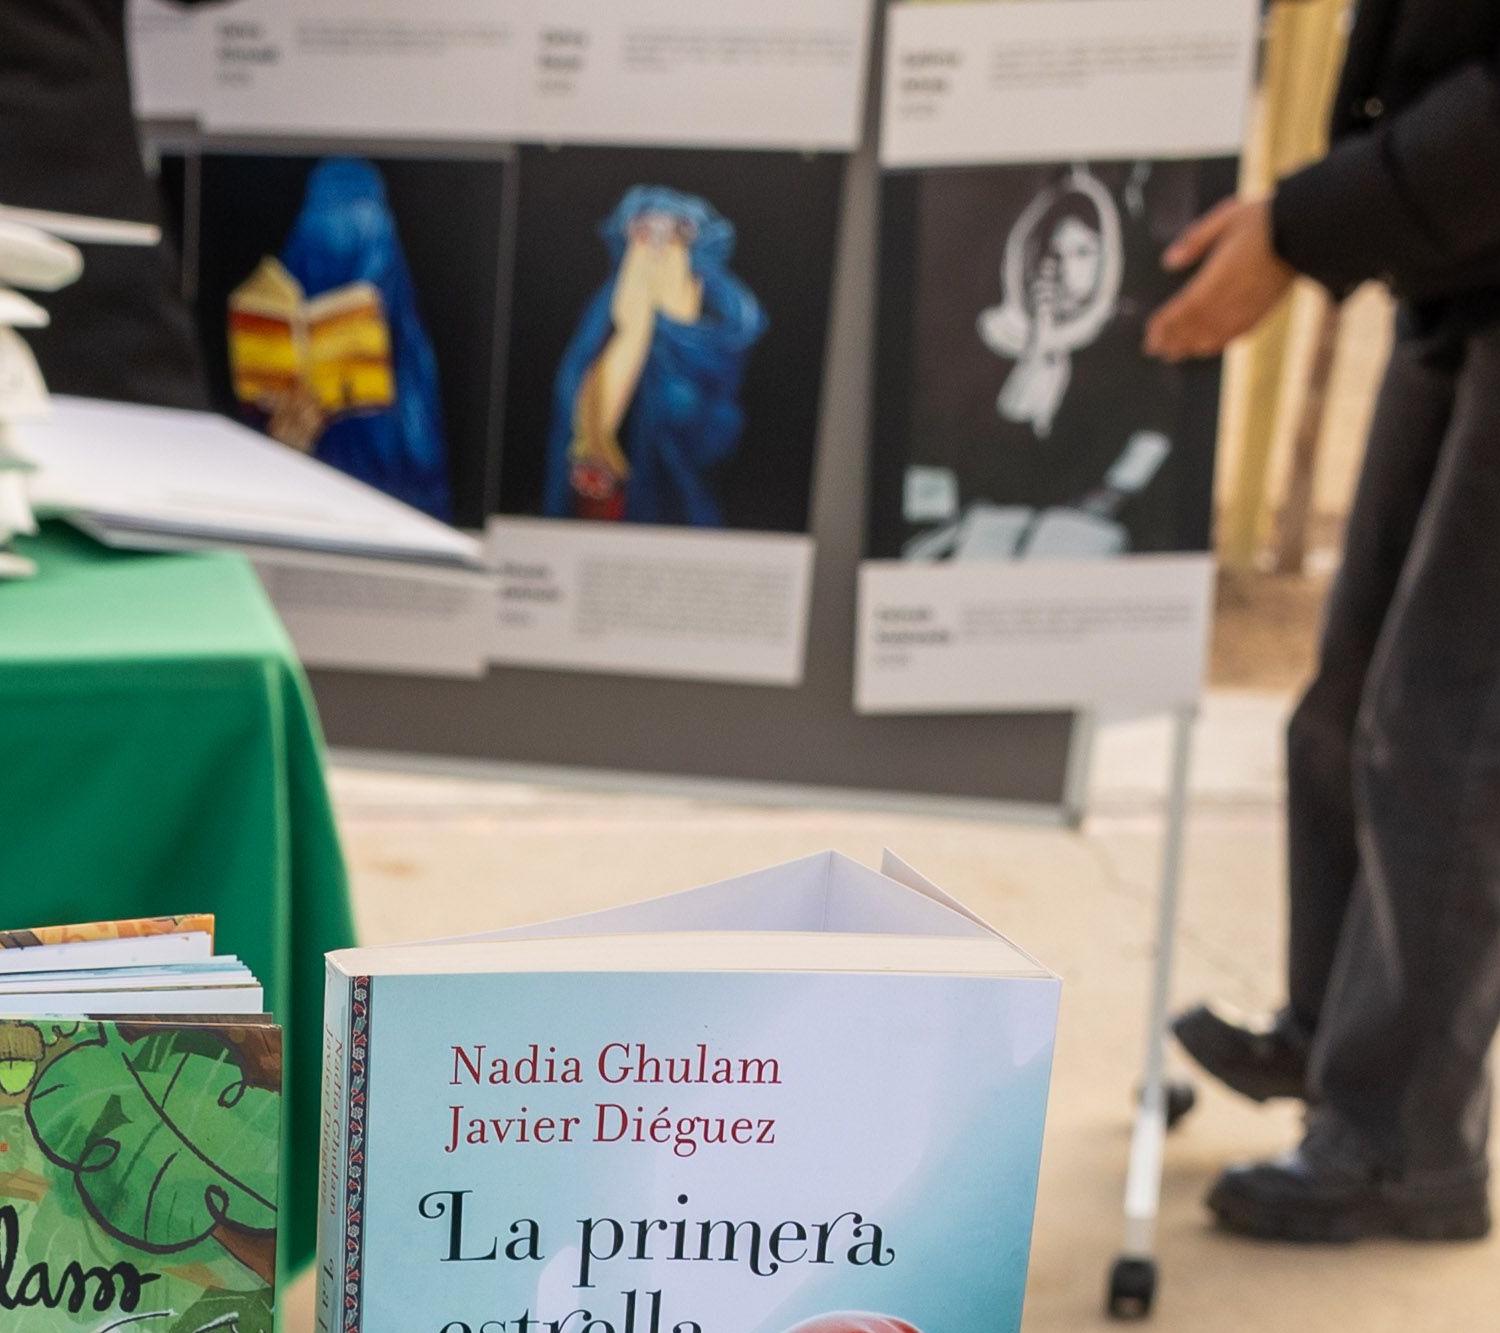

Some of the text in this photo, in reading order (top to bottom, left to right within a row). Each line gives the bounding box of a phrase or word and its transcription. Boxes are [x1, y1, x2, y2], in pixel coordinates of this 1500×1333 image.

[447, 1041, 782, 1085] Nadia Ghulam
[443, 1103, 777, 1157] Javier Diéguez
[417, 1188, 896, 1290] La primera
